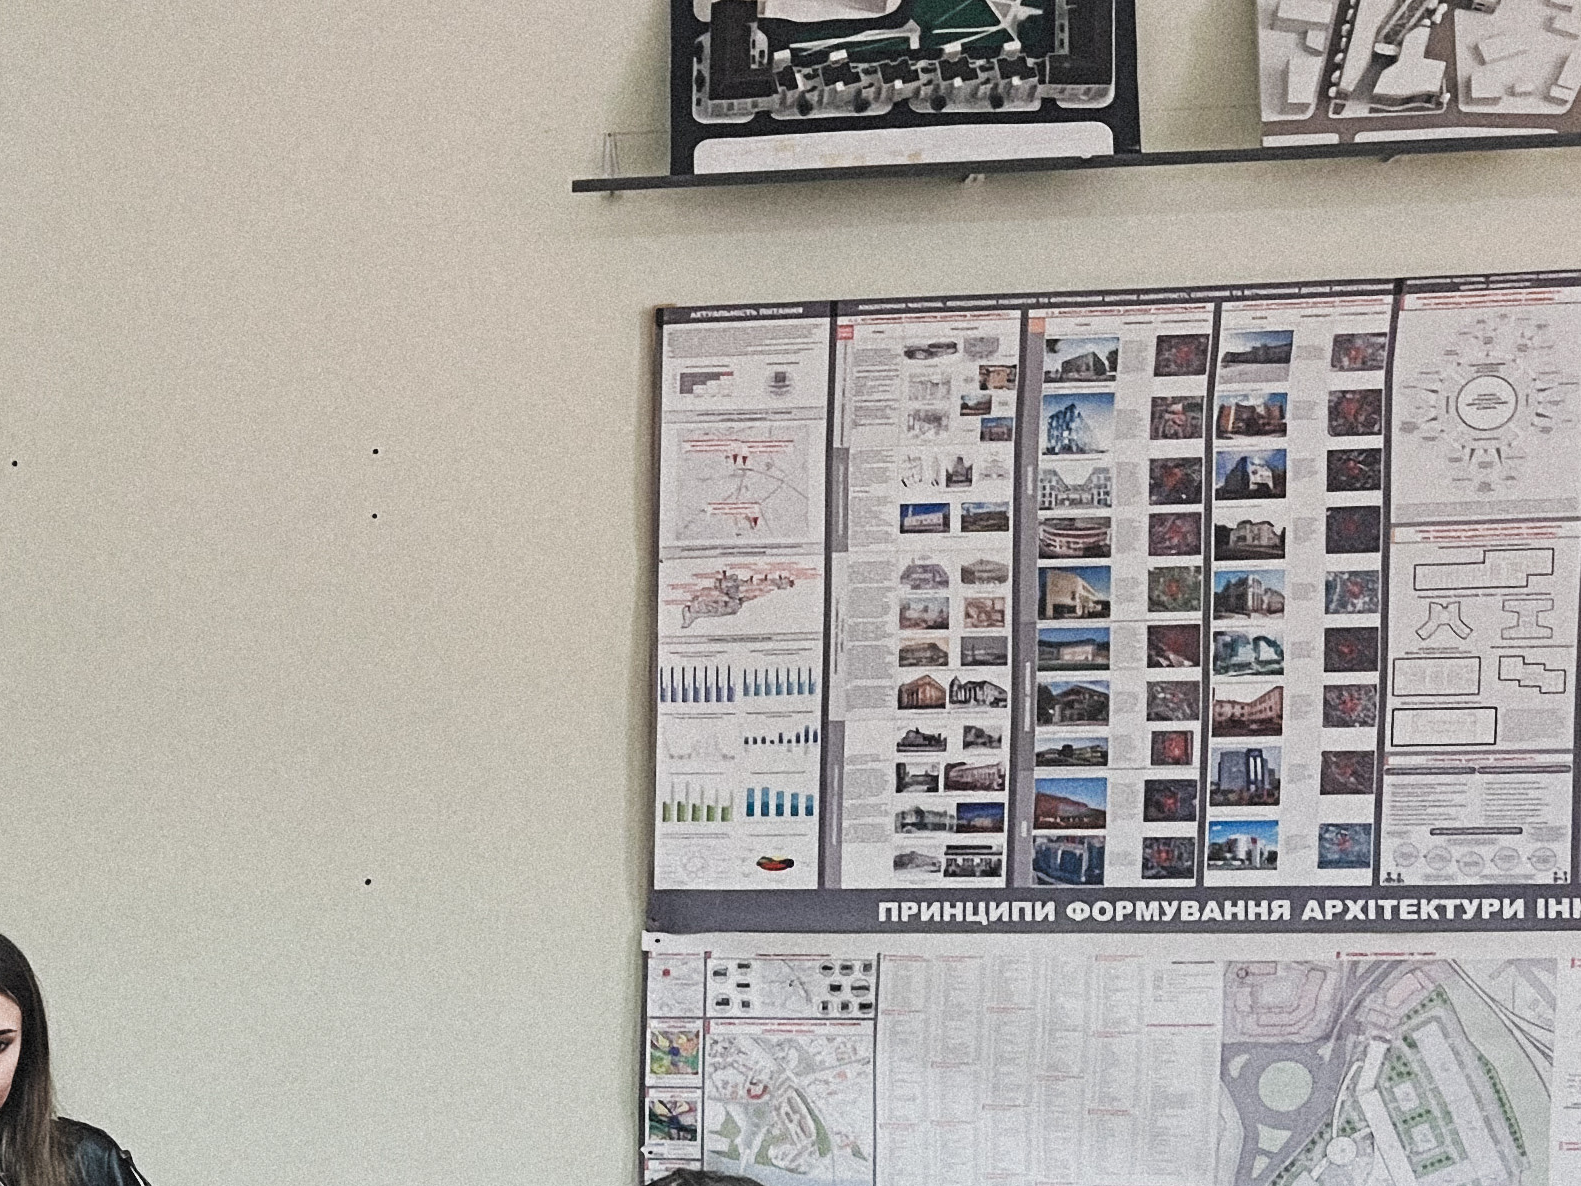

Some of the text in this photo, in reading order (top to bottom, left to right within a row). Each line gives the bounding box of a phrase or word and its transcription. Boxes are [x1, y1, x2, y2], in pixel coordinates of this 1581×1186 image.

[877, 900, 1056, 925] ПРИНЦИПИ
[1065, 900, 1291, 923] ФОРМУВАННЯ
[1301, 898, 1525, 922] АРХІТЕКТУРИ
